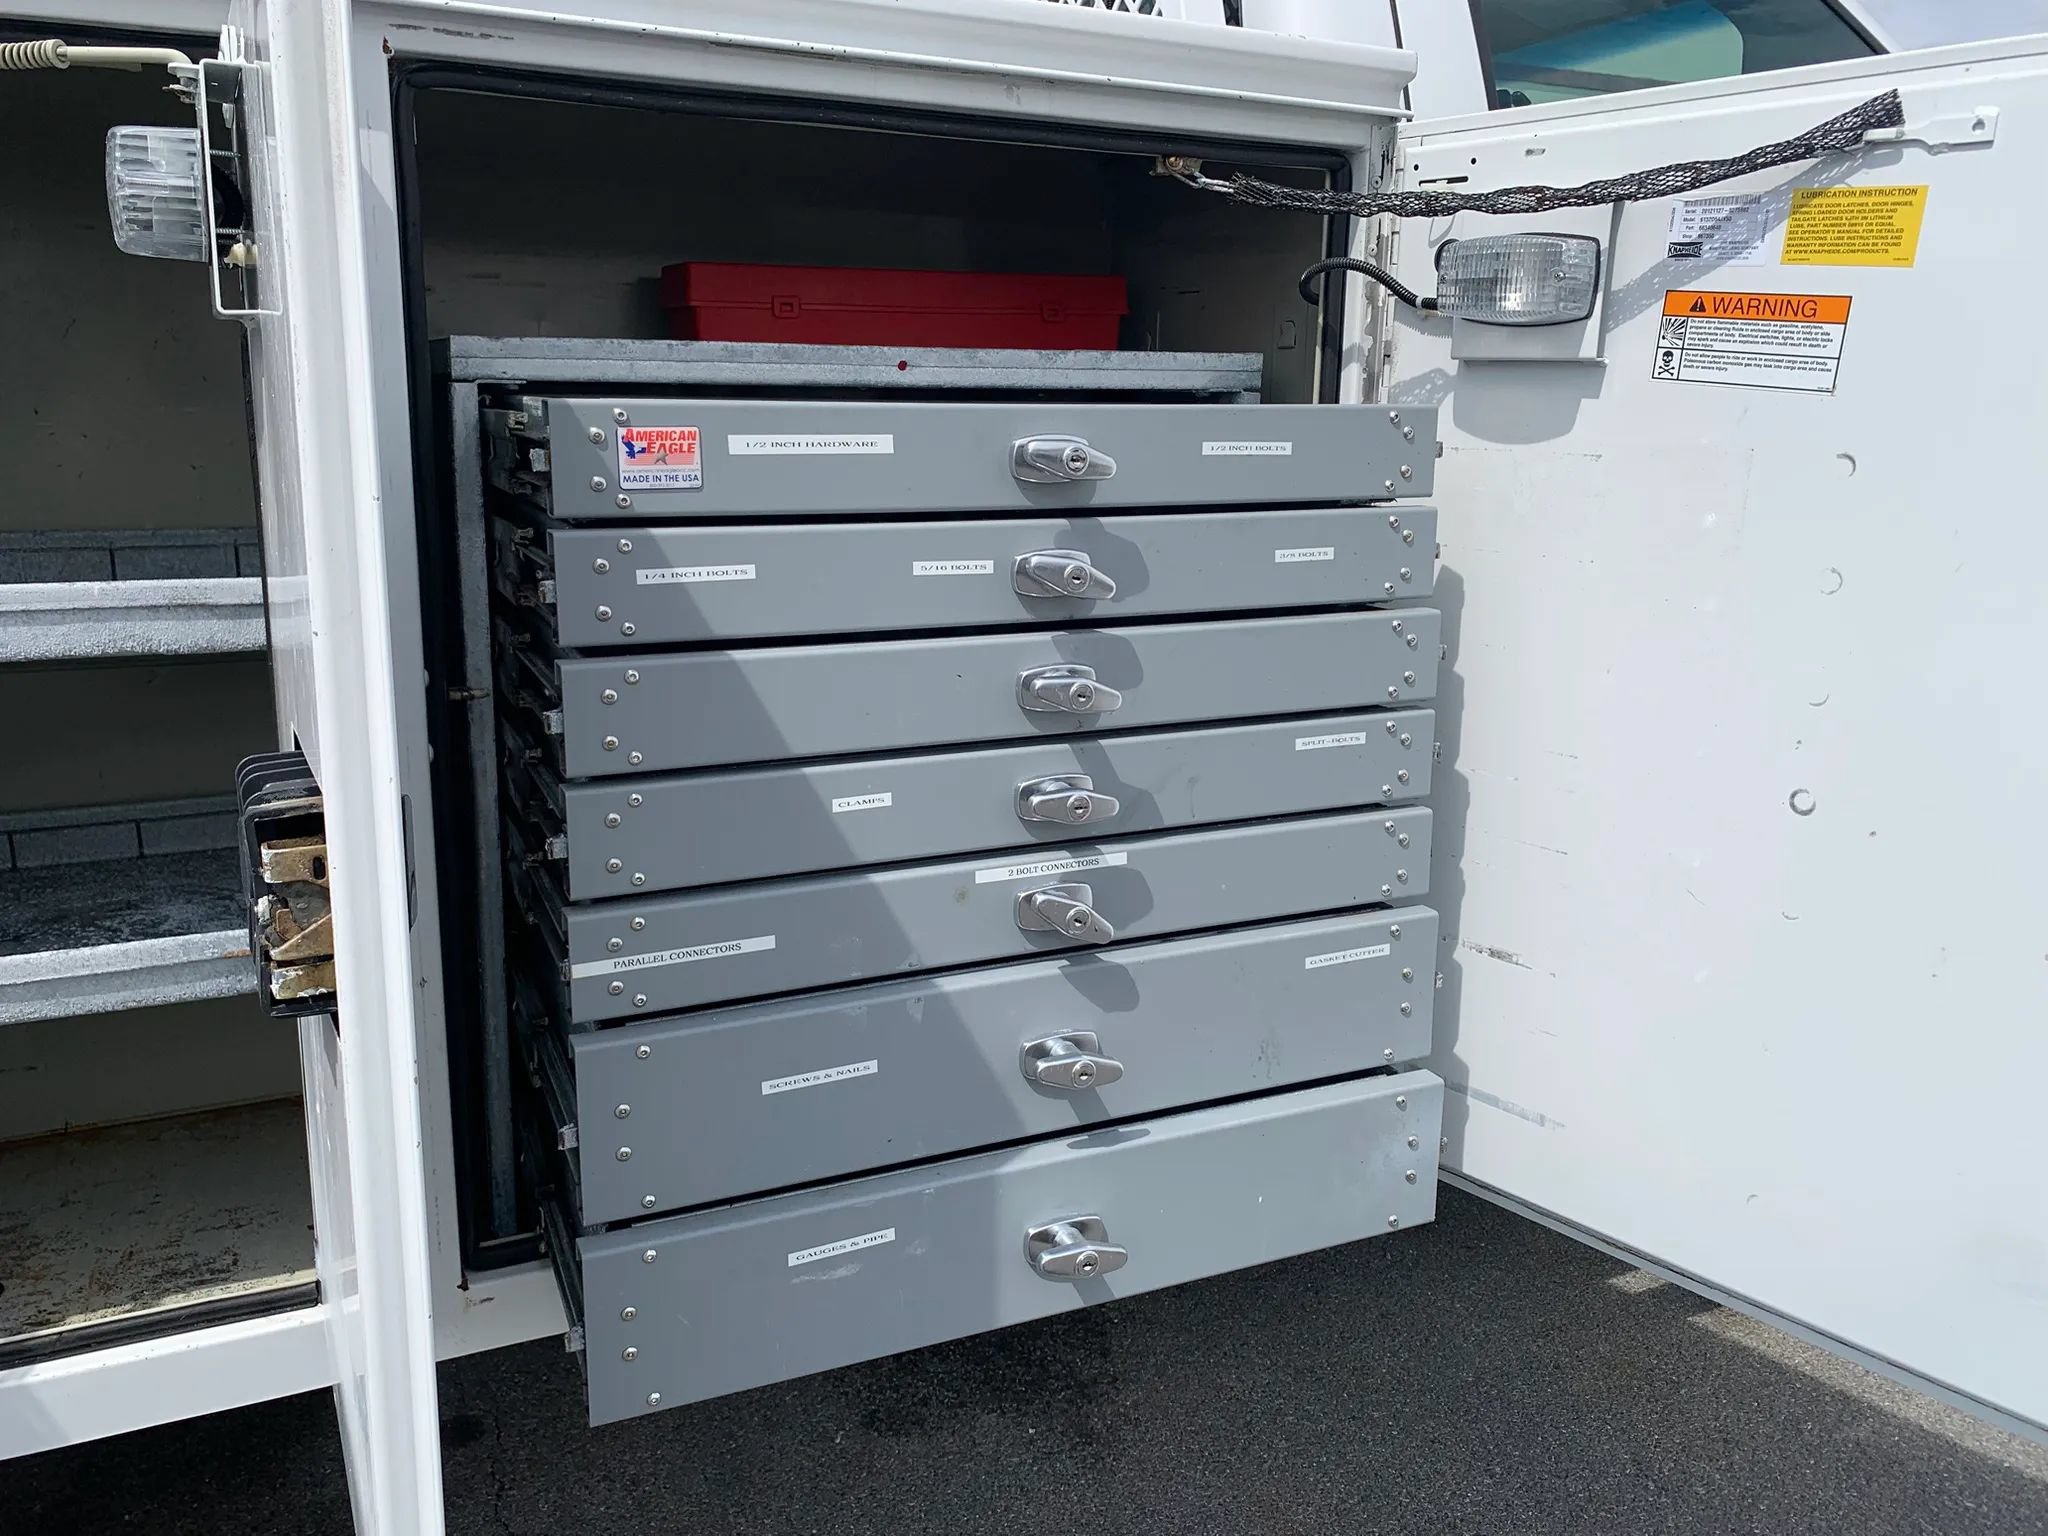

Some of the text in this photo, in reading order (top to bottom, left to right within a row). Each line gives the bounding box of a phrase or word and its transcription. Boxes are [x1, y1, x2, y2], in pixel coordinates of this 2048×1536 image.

[1802, 188, 1918, 198] LUBRICATION INSTRUCTION
[1668, 244, 1703, 256] KNAPHEIDE
[1713, 296, 1818, 318] WARNING
[624, 429, 697, 442] AMERICAN
[647, 442, 696, 454] EAGLE
[623, 475, 650, 483] MADE
[839, 798, 884, 807] CLAMPS
[1016, 866, 1039, 876] BOLT
[1041, 858, 1099, 872] CONNECTORS
[614, 943, 742, 969] PARALLEL CONNECTORS
[1310, 948, 1384, 965] GASKET CUTTER
[769, 1076, 820, 1090] SCREWS
[836, 1065, 870, 1076] NAILS
[796, 1244, 846, 1260] GAUGES
[864, 1234, 888, 1243] PIPE
